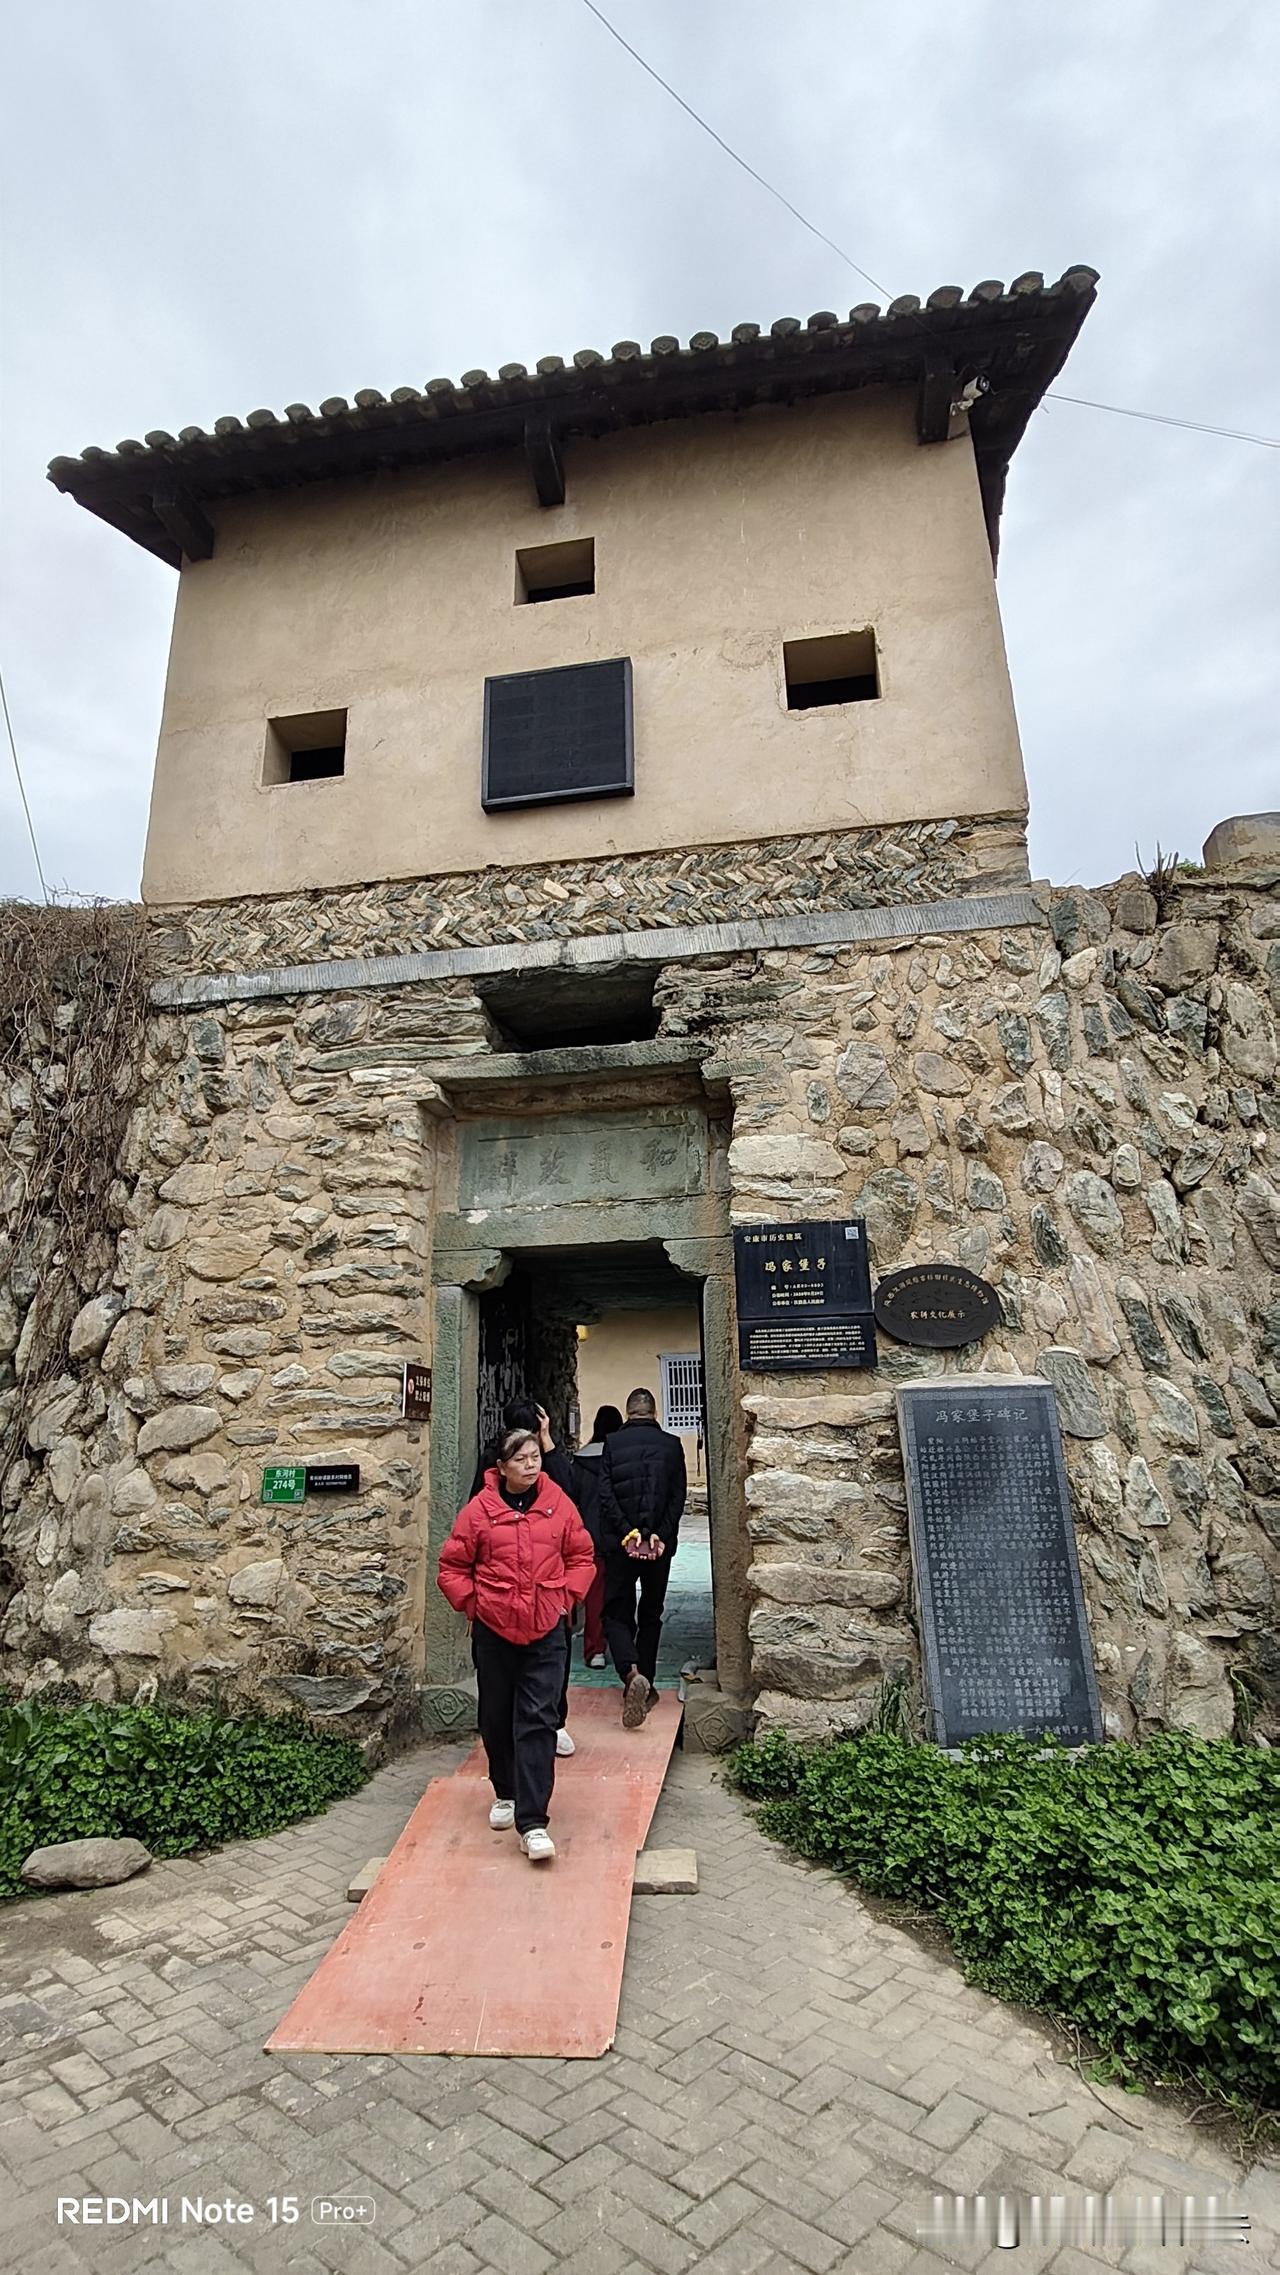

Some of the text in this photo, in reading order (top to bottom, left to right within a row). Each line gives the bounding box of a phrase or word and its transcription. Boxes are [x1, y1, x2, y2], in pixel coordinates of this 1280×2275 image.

[743, 1232, 803, 1243] 安康市历史建筑
[764, 1257, 827, 1273] 冯家堡子
[935, 1407, 1029, 1423] 冯家堡子碑记
[272, 1479, 296, 1490] 274号
